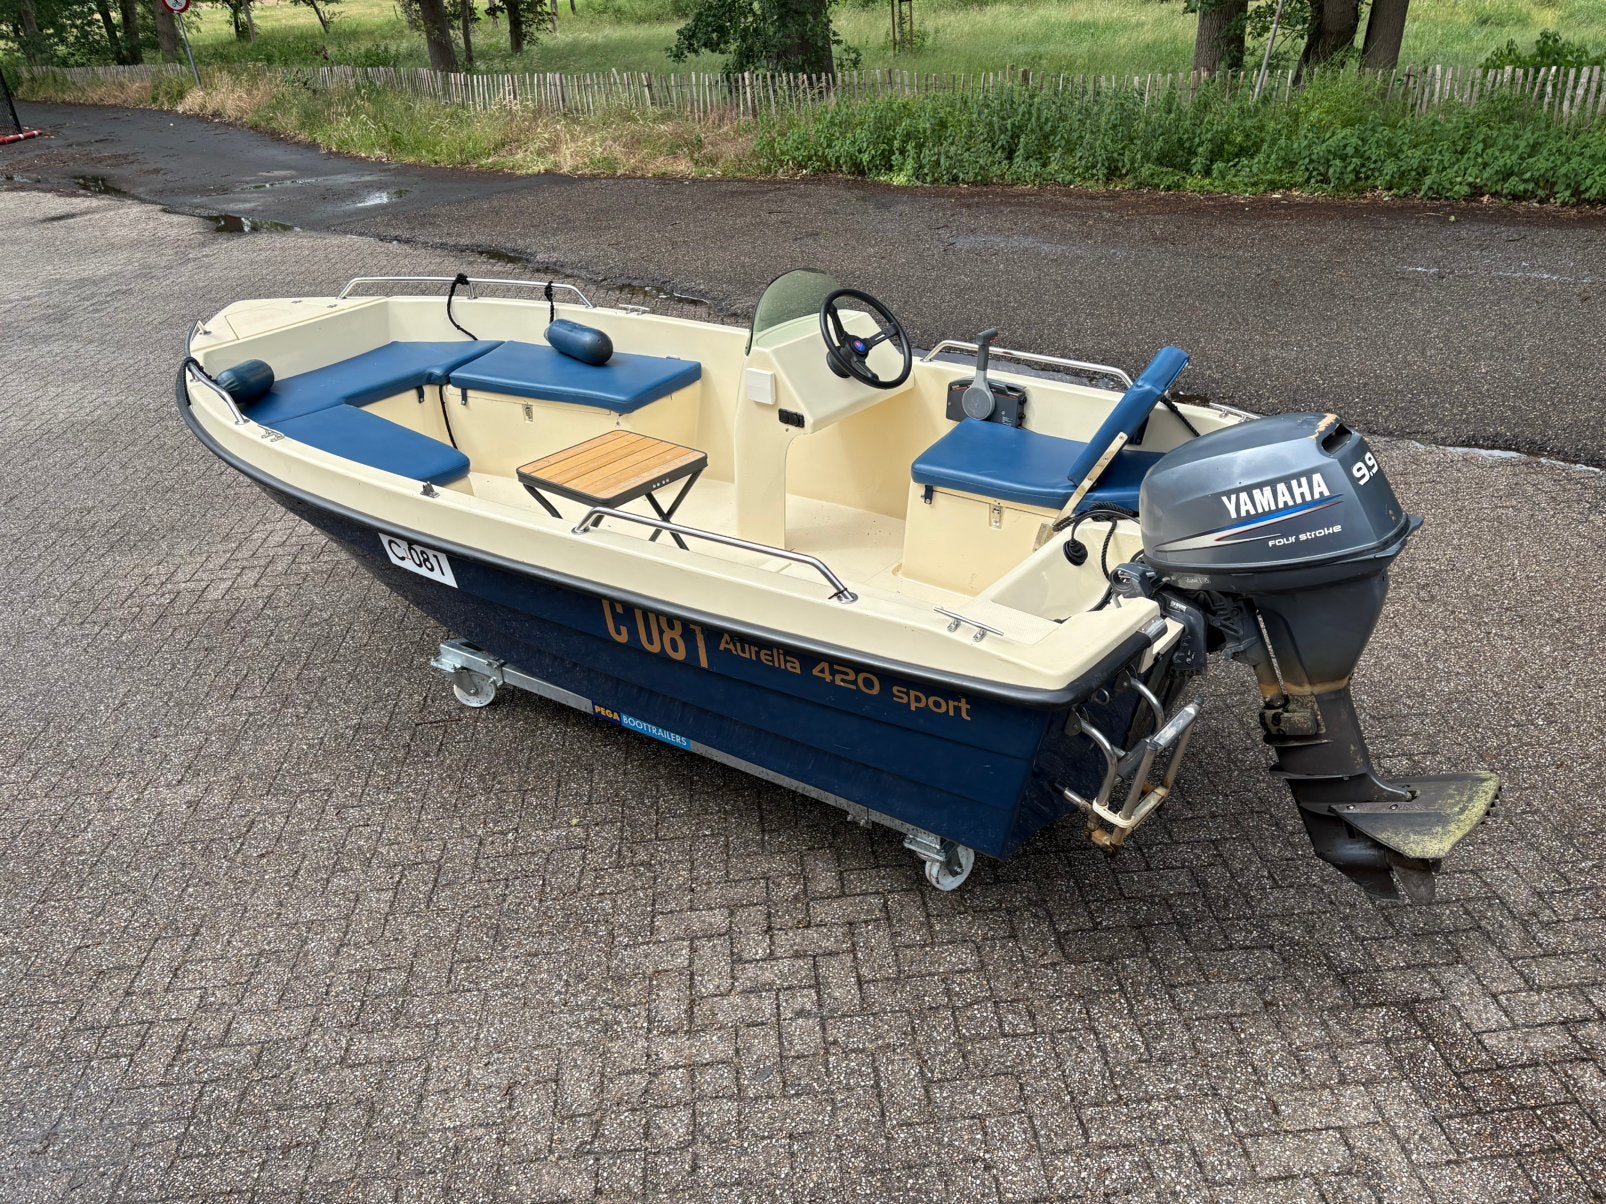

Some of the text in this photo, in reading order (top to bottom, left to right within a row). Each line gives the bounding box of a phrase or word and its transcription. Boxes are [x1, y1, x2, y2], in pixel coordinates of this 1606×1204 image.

[1352, 451, 1379, 486] 9.9
[1221, 473, 1331, 519] YAMAHA
[601, 599, 709, 669] C 081
[718, 631, 972, 721] Aurelia 420 sport
[594, 704, 688, 746] PEGA BOOTTRAILERS
